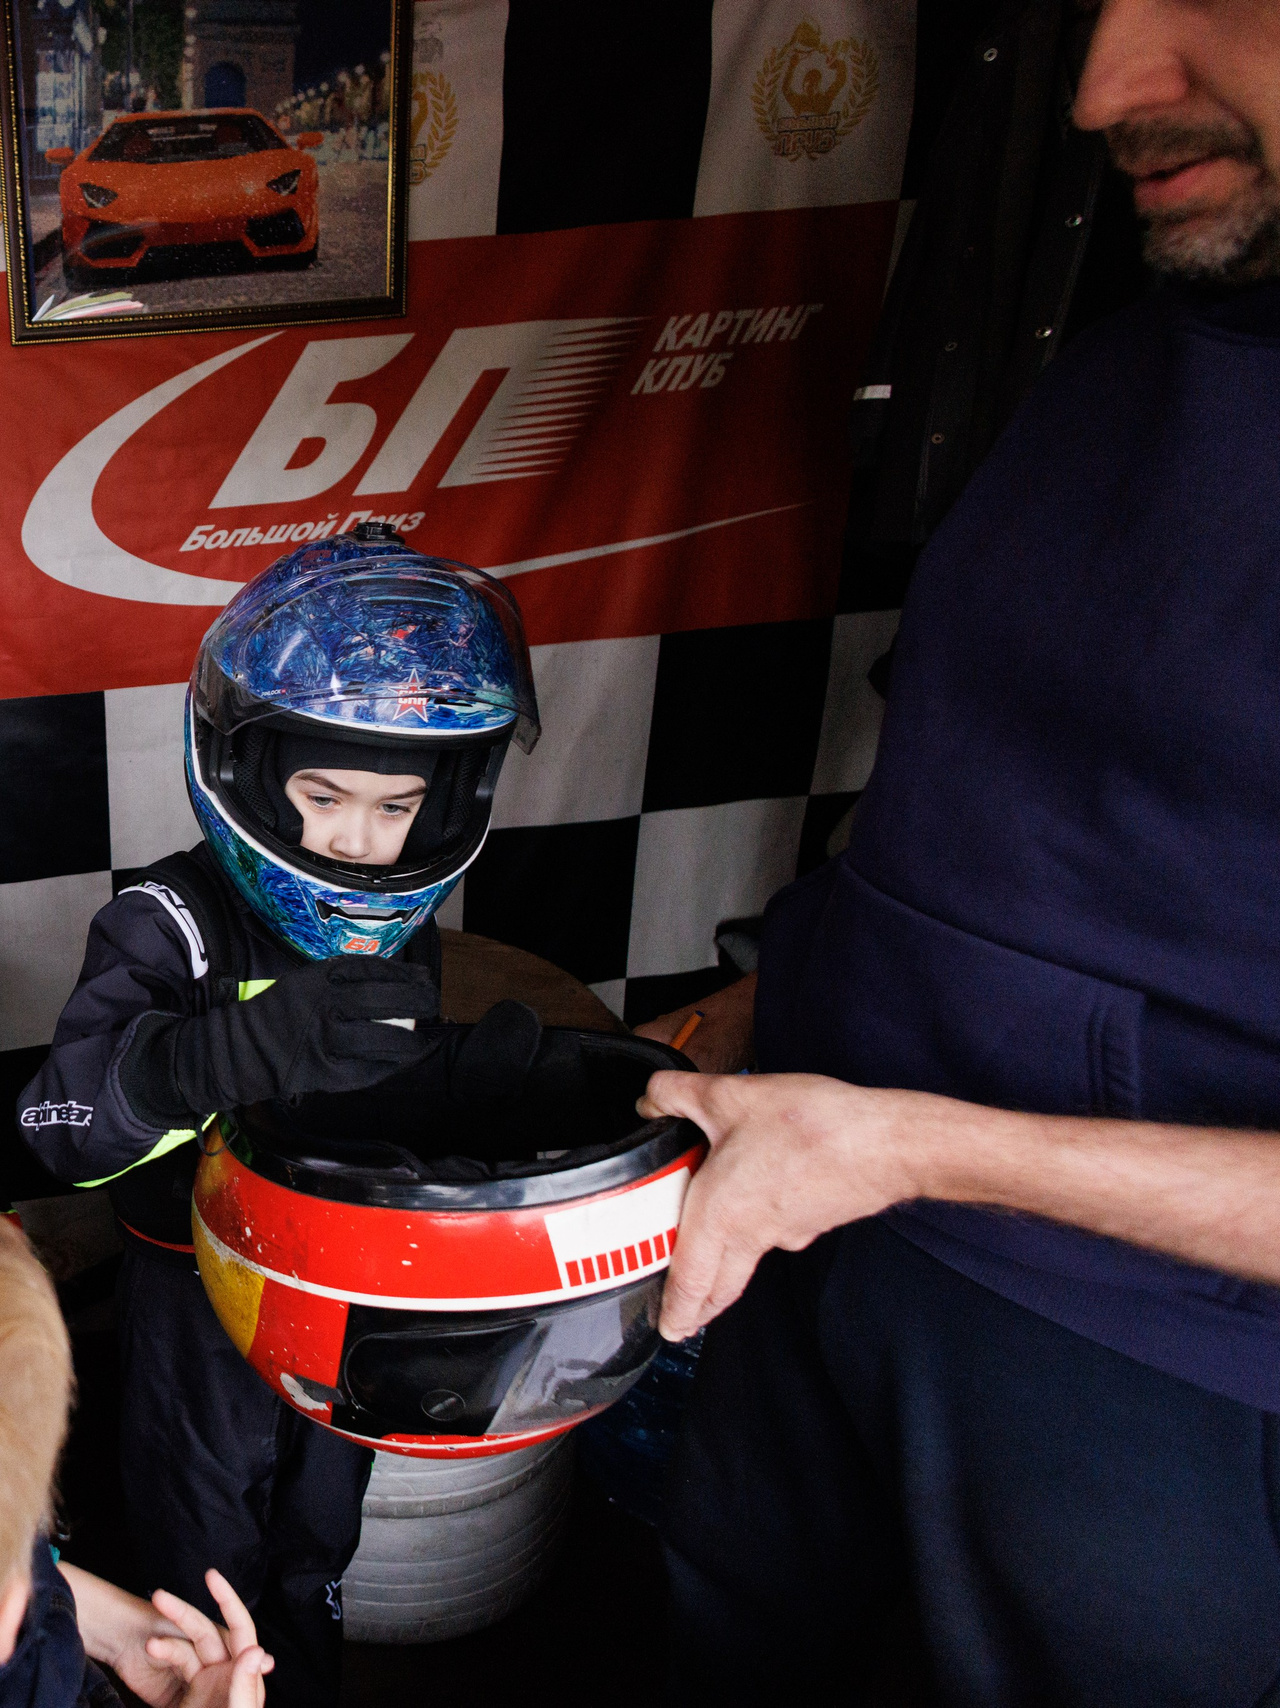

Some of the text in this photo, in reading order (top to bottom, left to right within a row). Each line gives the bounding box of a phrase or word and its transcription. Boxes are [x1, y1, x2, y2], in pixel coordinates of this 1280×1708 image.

[652, 303, 824, 352] КАРТИНГ
[630, 352, 735, 395] КЛУБ
[208, 316, 656, 509] БП
[179, 513, 339, 552] Большой
